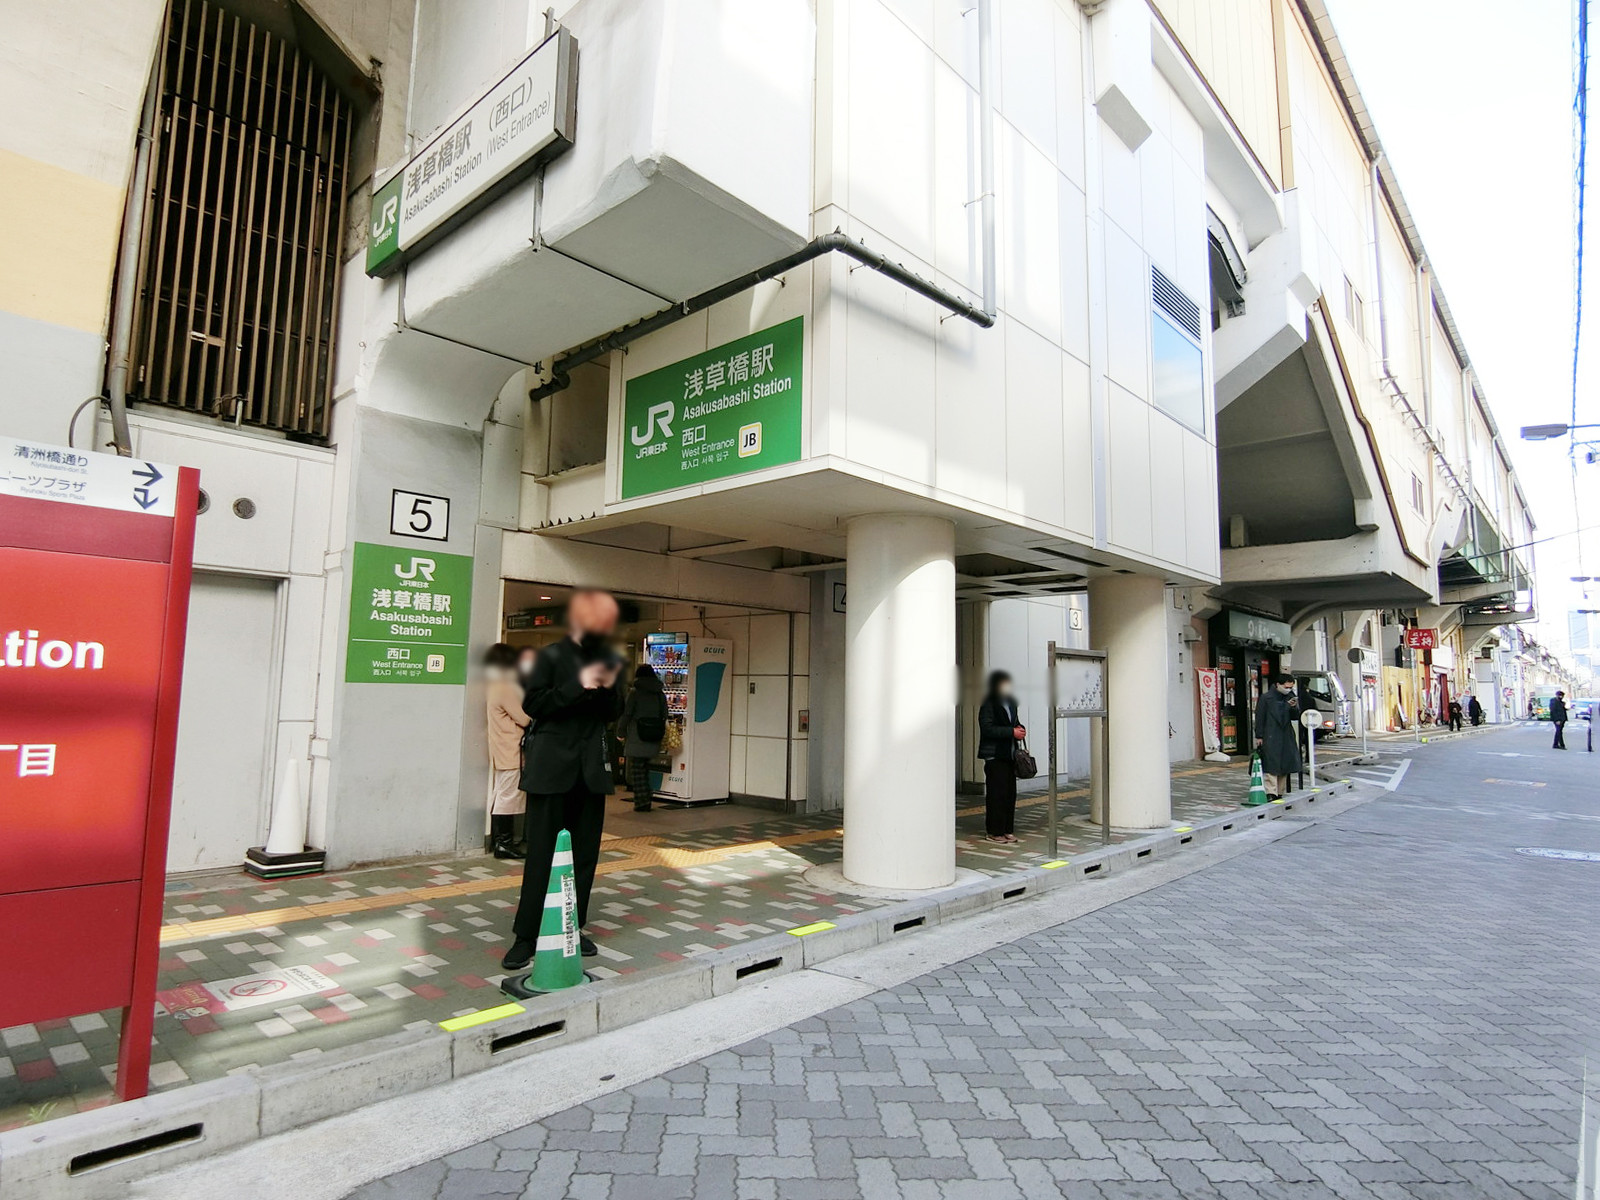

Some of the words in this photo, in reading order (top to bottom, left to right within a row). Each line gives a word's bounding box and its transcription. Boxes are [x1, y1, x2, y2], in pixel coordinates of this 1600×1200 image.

[404, 175, 453, 224] Asakusabashi
[454, 151, 482, 185] Station
[486, 134, 509, 161] (West
[510, 91, 551, 139] Entrance)
[406, 120, 473, 200] 浅草橋駅
[372, 195, 398, 238] JR
[683, 343, 774, 400] 浅草橋駅
[683, 387, 750, 421] Asakusabashi
[753, 376, 792, 400] Station
[631, 401, 675, 446] JR
[682, 425, 706, 447] 西口
[743, 432, 757, 448] JB
[13, 444, 88, 467] 清洲橋通り
[636, 442, 668, 459] JR東日本
[682, 447, 700, 459] West
[701, 437, 735, 454] Entrance
[409, 498, 432, 532] 5
[395, 557, 436, 581] JR
[372, 588, 451, 613] 浅草橋駅
[370, 610, 452, 626] Asakusabashi
[1073, 611, 1079, 627] 3
[390, 624, 432, 637] Station
[1408, 636, 1433, 647] 王将
[0, 630, 105, 670] tion
[386, 648, 410, 660] 西口
[703, 645, 726, 655] acure
[372, 660, 391, 668] West
[392, 661, 423, 670] Entrance
